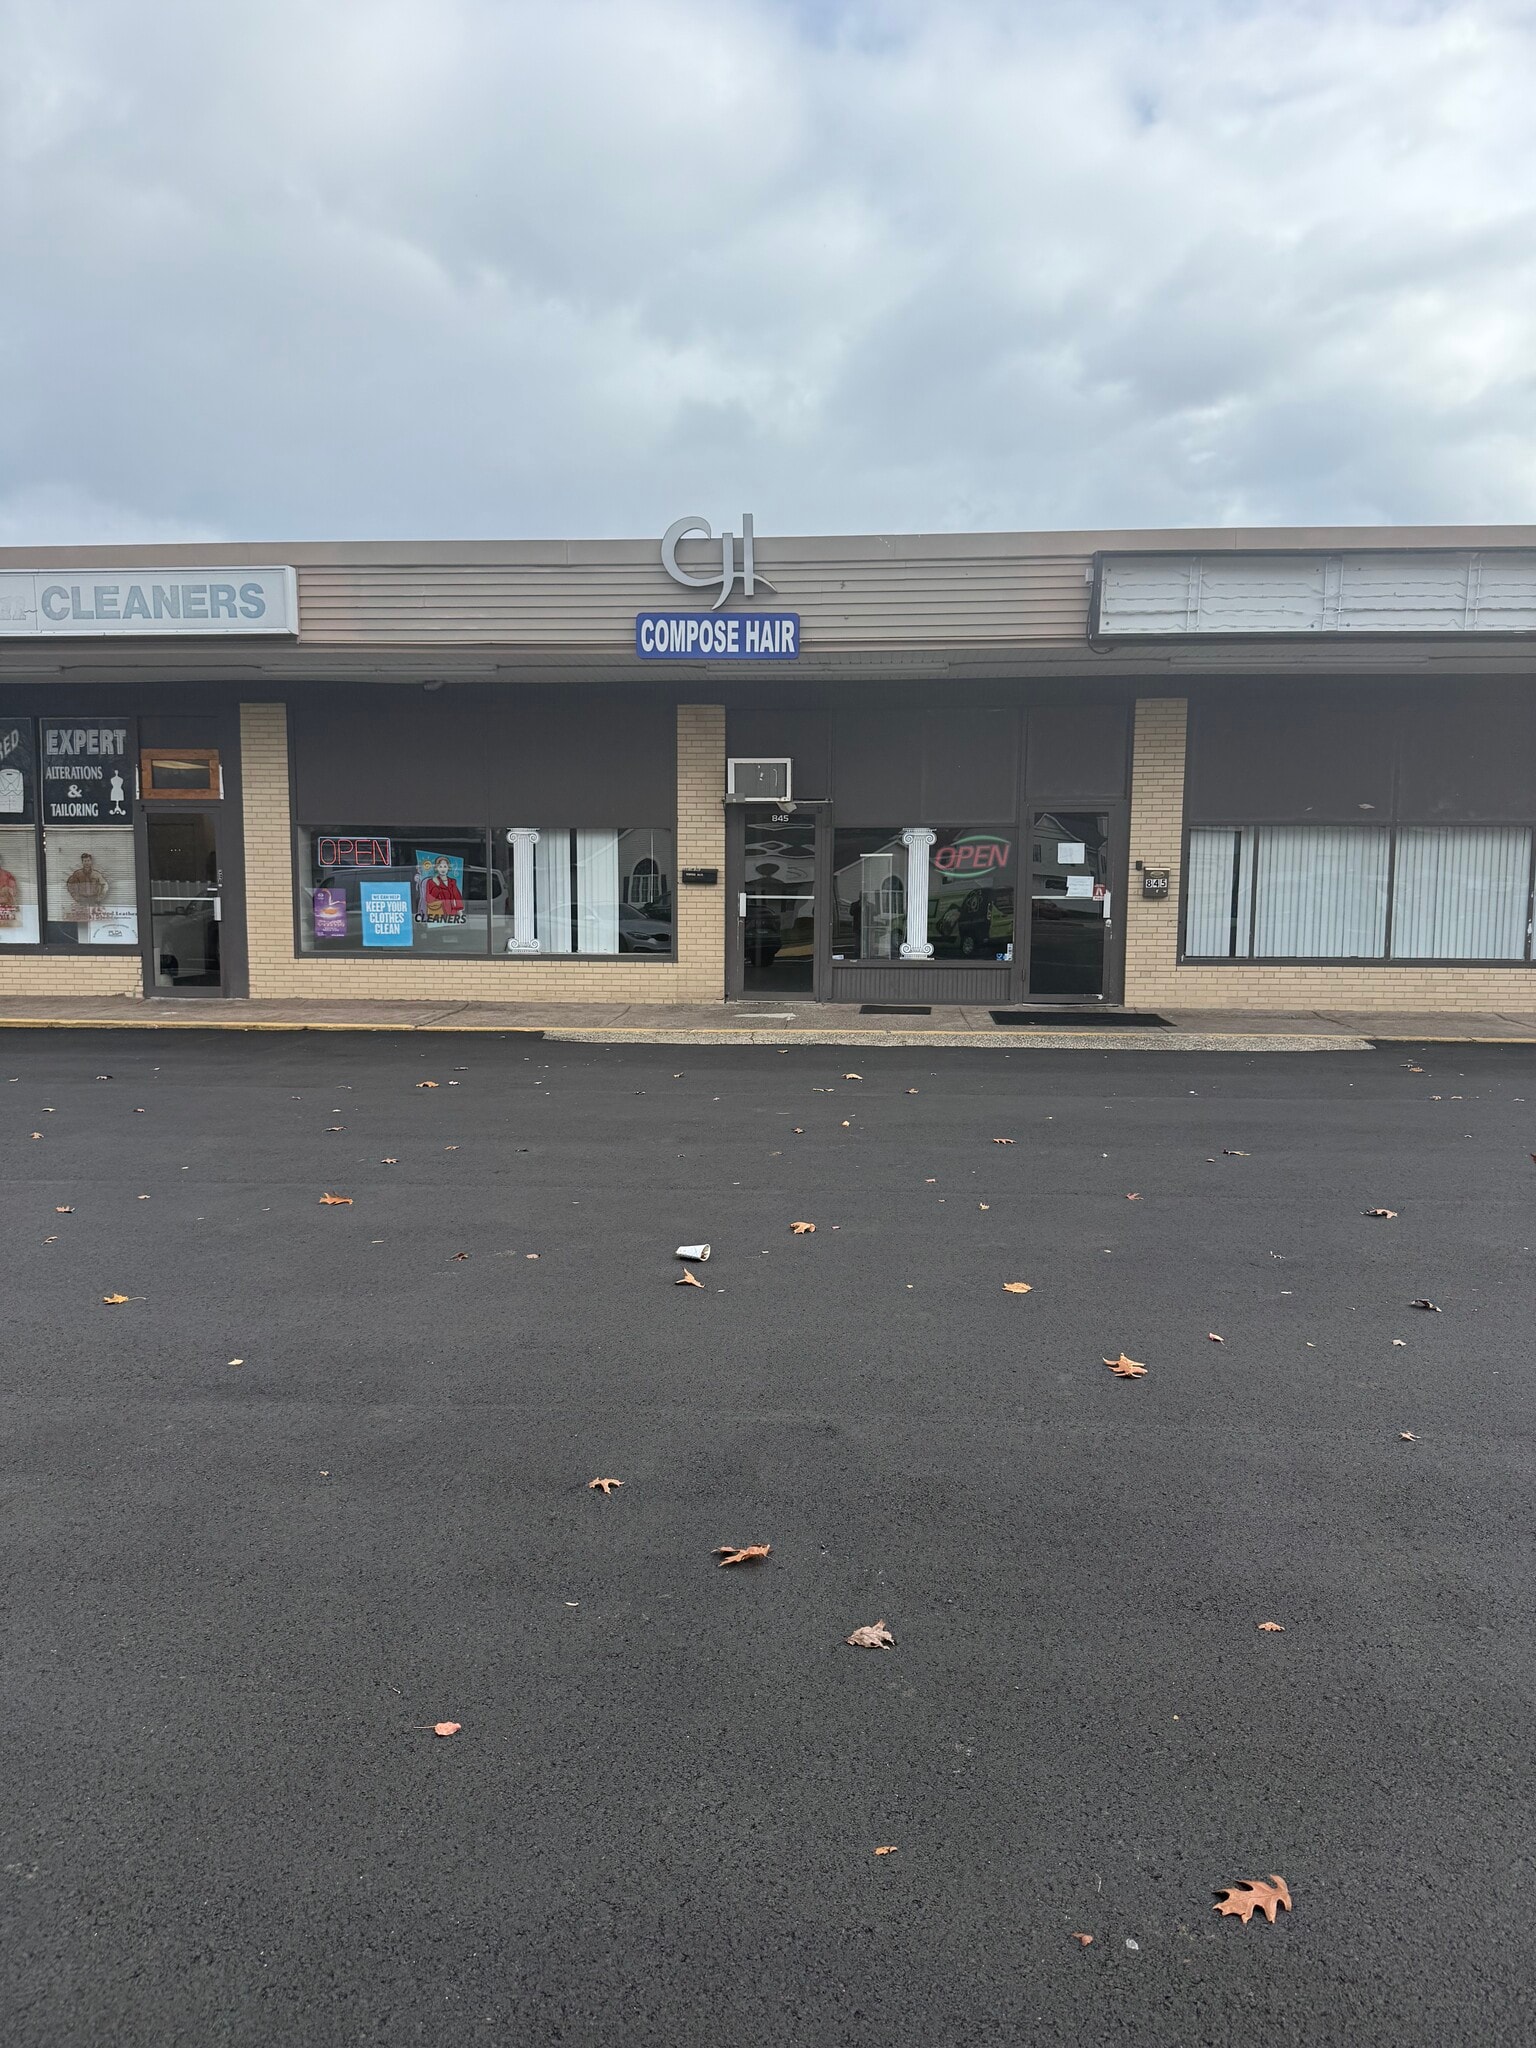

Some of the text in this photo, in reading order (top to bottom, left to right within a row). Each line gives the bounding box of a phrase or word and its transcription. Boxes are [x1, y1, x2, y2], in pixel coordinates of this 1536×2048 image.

[41, 582, 267, 621] CLEANERS
[641, 619, 796, 653] COMPOSE HAIR
[46, 729, 127, 755] EXPERT
[45, 766, 103, 780] ALTERATIONS
[67, 784, 82, 798] &
[50, 803, 99, 817] TAILORING
[771, 814, 790, 823] 845
[320, 839, 389, 865] OPEN
[935, 844, 1009, 870] OPEN
[1146, 879, 1166, 888] 845
[365, 901, 408, 912] KEEP YOUR
[369, 912, 405, 924] CLOTHES
[414, 912, 467, 924] CLEANERS
[374, 923, 401, 934] CLEAN
